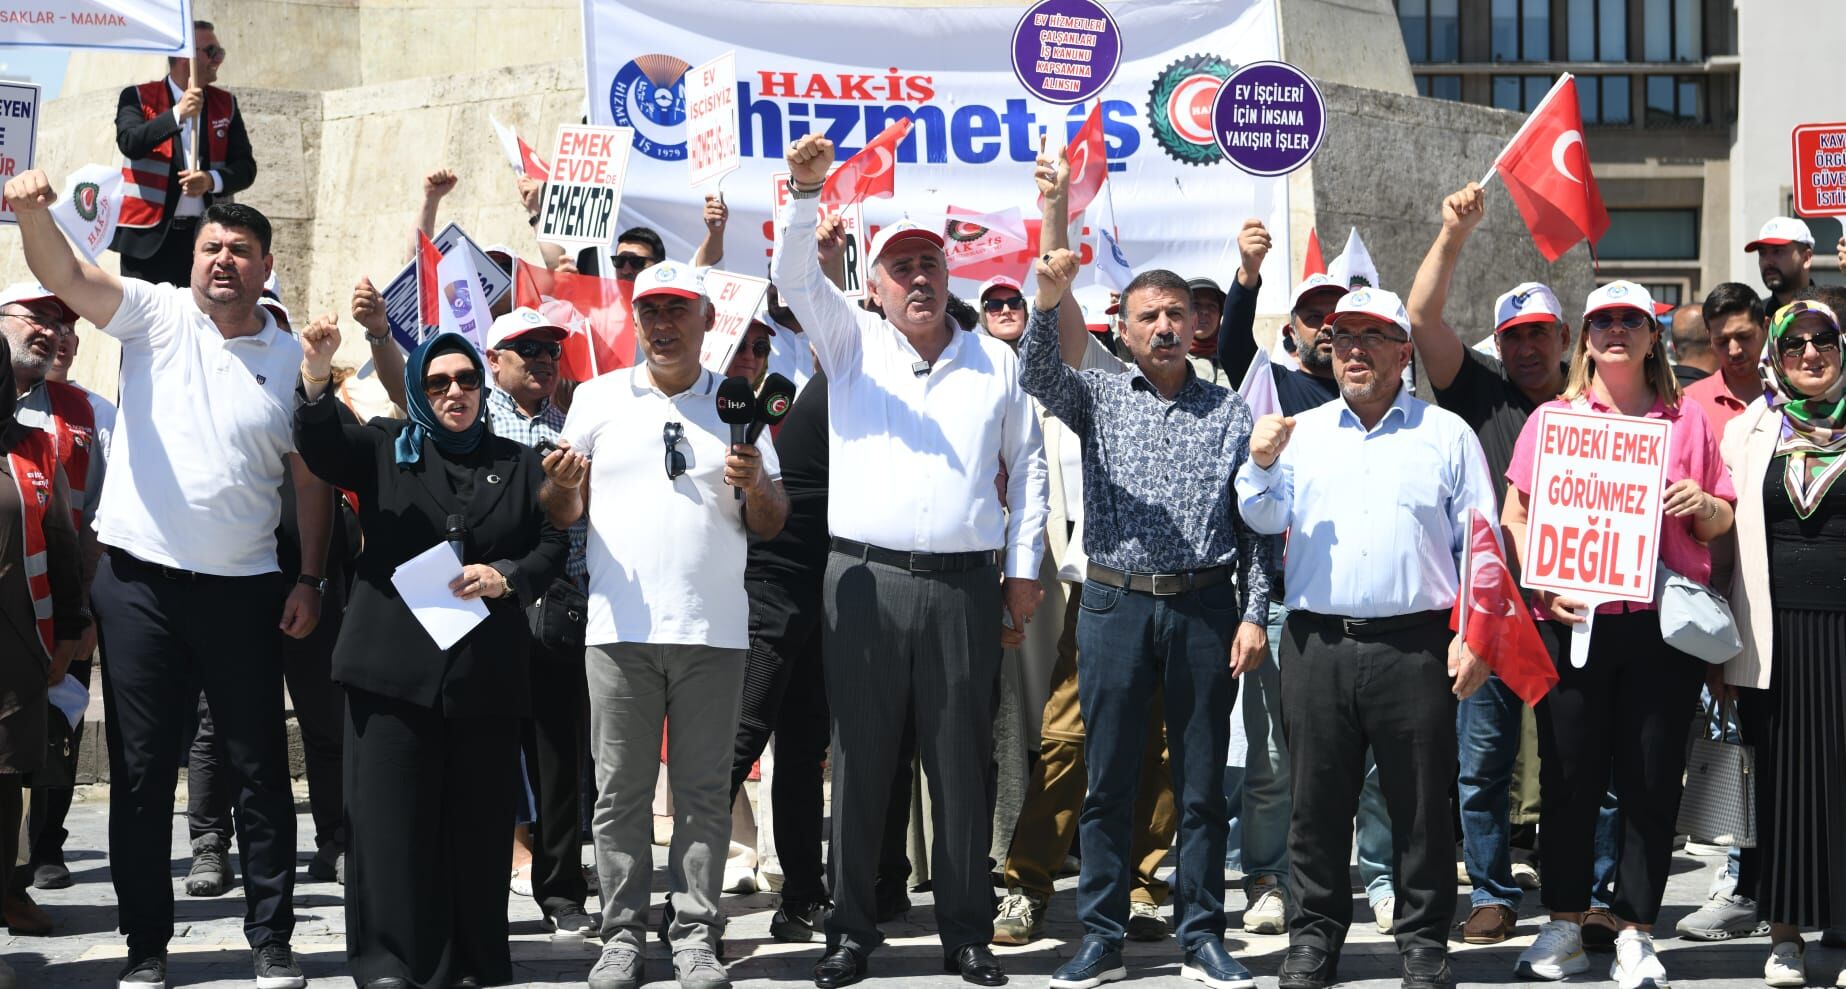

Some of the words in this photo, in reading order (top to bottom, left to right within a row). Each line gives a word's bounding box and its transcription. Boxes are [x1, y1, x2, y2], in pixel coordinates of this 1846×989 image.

[71, 12, 127, 27] MAMAK
[1034, 13, 1048, 26] EV
[1049, 12, 1107, 32] HİZMETLERİ
[1052, 46, 1092, 62] KANUNU
[703, 68, 715, 87] EV
[1036, 60, 1092, 78] KAPSAMINA
[757, 67, 935, 104] HAK-İŞ
[1042, 77, 1081, 92] ALINSIN
[1235, 84, 1251, 100] EV
[1254, 82, 1304, 105] İŞÇİLERİ
[613, 81, 630, 127] HİZME
[1233, 104, 1258, 126] İÇİN
[1261, 105, 1304, 126] İNSANA
[559, 132, 614, 158] EMEK
[1226, 131, 1272, 151] YAKIŞIR
[1275, 129, 1309, 152] İŞLER
[1820, 133, 1846, 148] KAY
[656, 147, 681, 157] 1979
[554, 158, 608, 184] EVDE
[543, 184, 614, 239] EMEKTİR
[719, 282, 742, 301] EV
[1544, 424, 1609, 460] EVDEKİ
[1612, 431, 1661, 466] EMEK
[1548, 469, 1648, 515] GÖRÜNMEZ
[1536, 516, 1625, 587] DEĞİL
[1634, 535, 1646, 589] !
